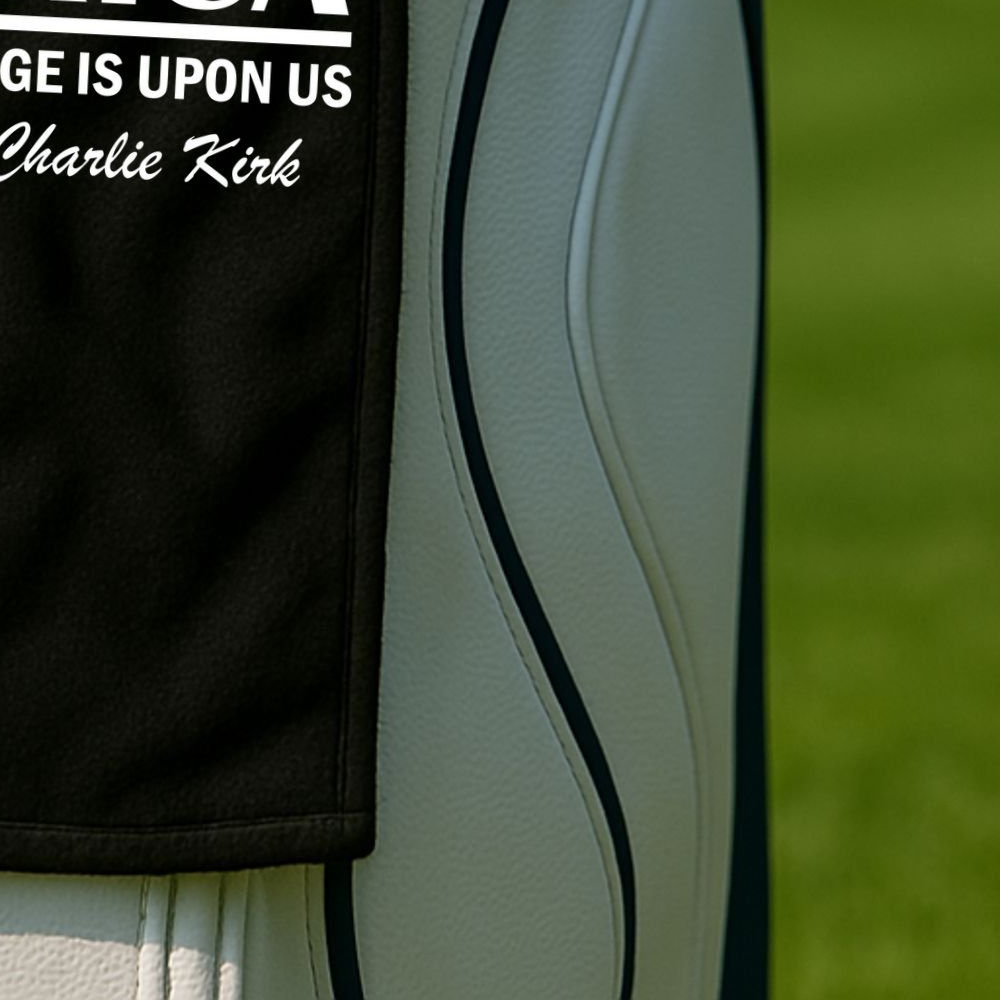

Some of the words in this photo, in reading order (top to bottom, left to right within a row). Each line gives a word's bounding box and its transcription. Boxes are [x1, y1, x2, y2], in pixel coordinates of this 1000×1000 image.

[78, 51, 123, 97] IS
[138, 55, 272, 104] UPON
[288, 63, 352, 109] US
[183, 133, 303, 188] Kirk
